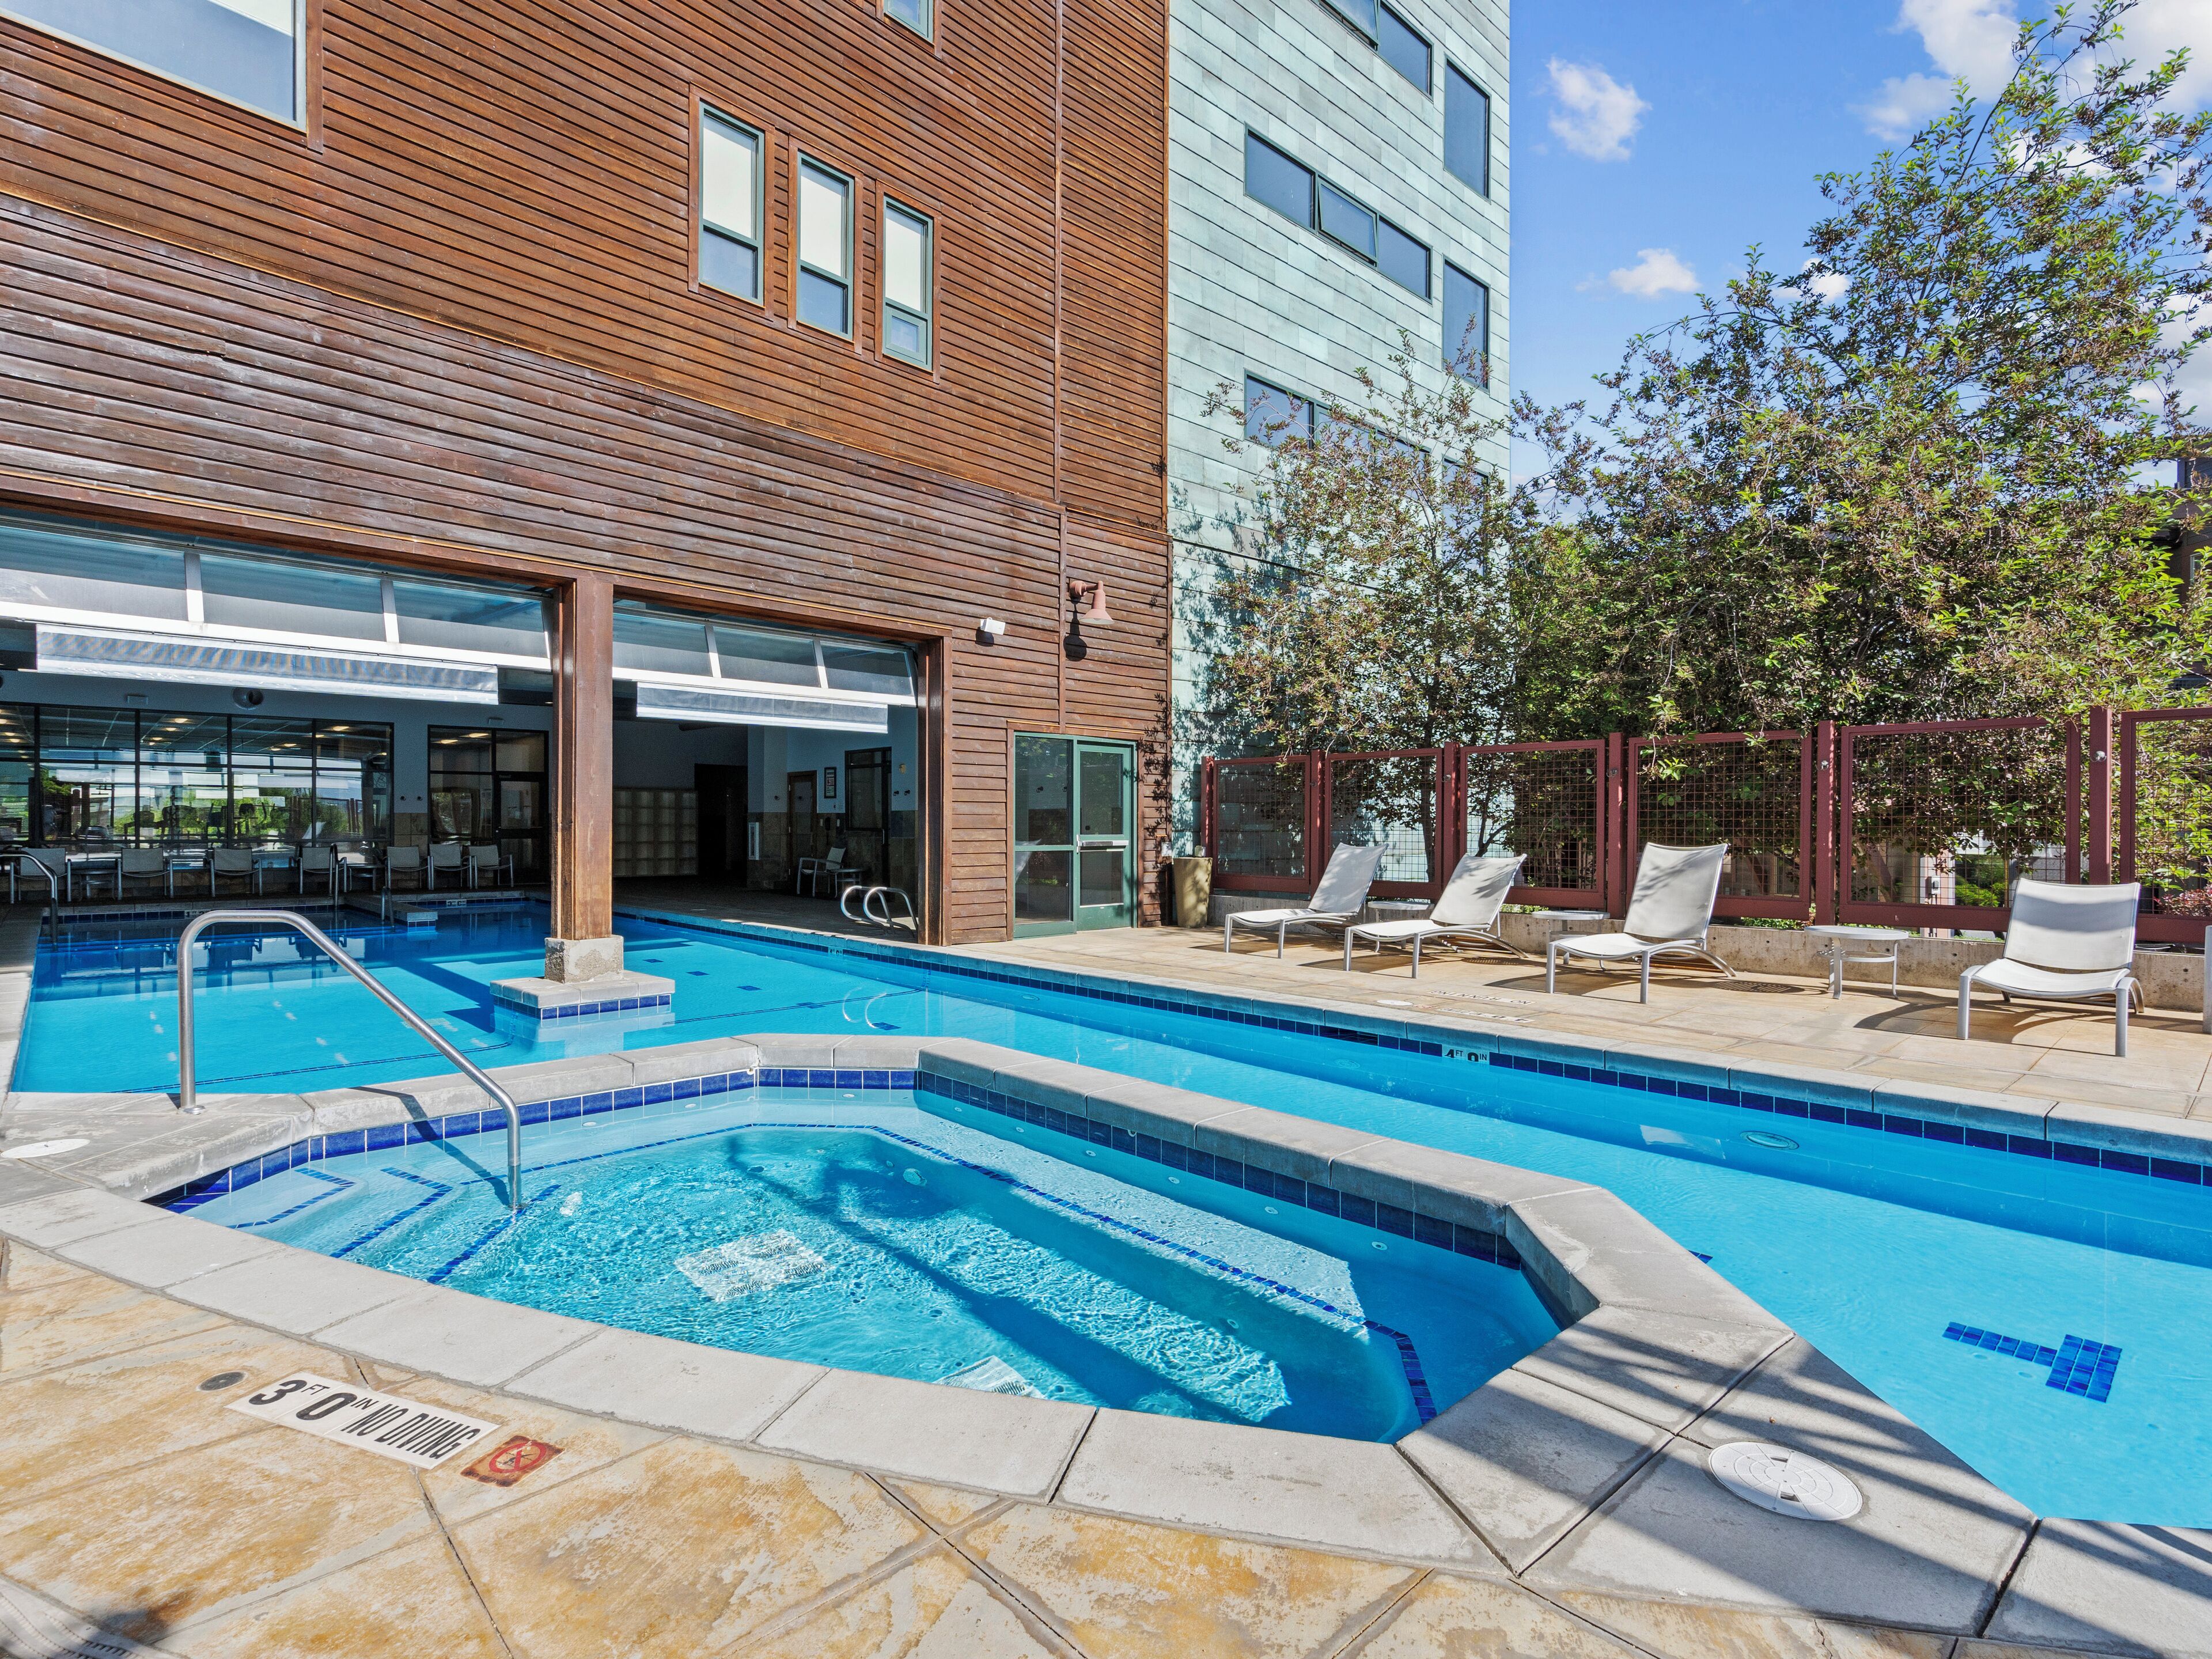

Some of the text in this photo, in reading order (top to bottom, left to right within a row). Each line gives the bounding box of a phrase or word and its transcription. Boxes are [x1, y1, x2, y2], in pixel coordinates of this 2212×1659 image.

[1431, 990, 1501, 1001] RUNNING
[249, 1380, 481, 1460] 3 FT 0 IN NO DIVING
